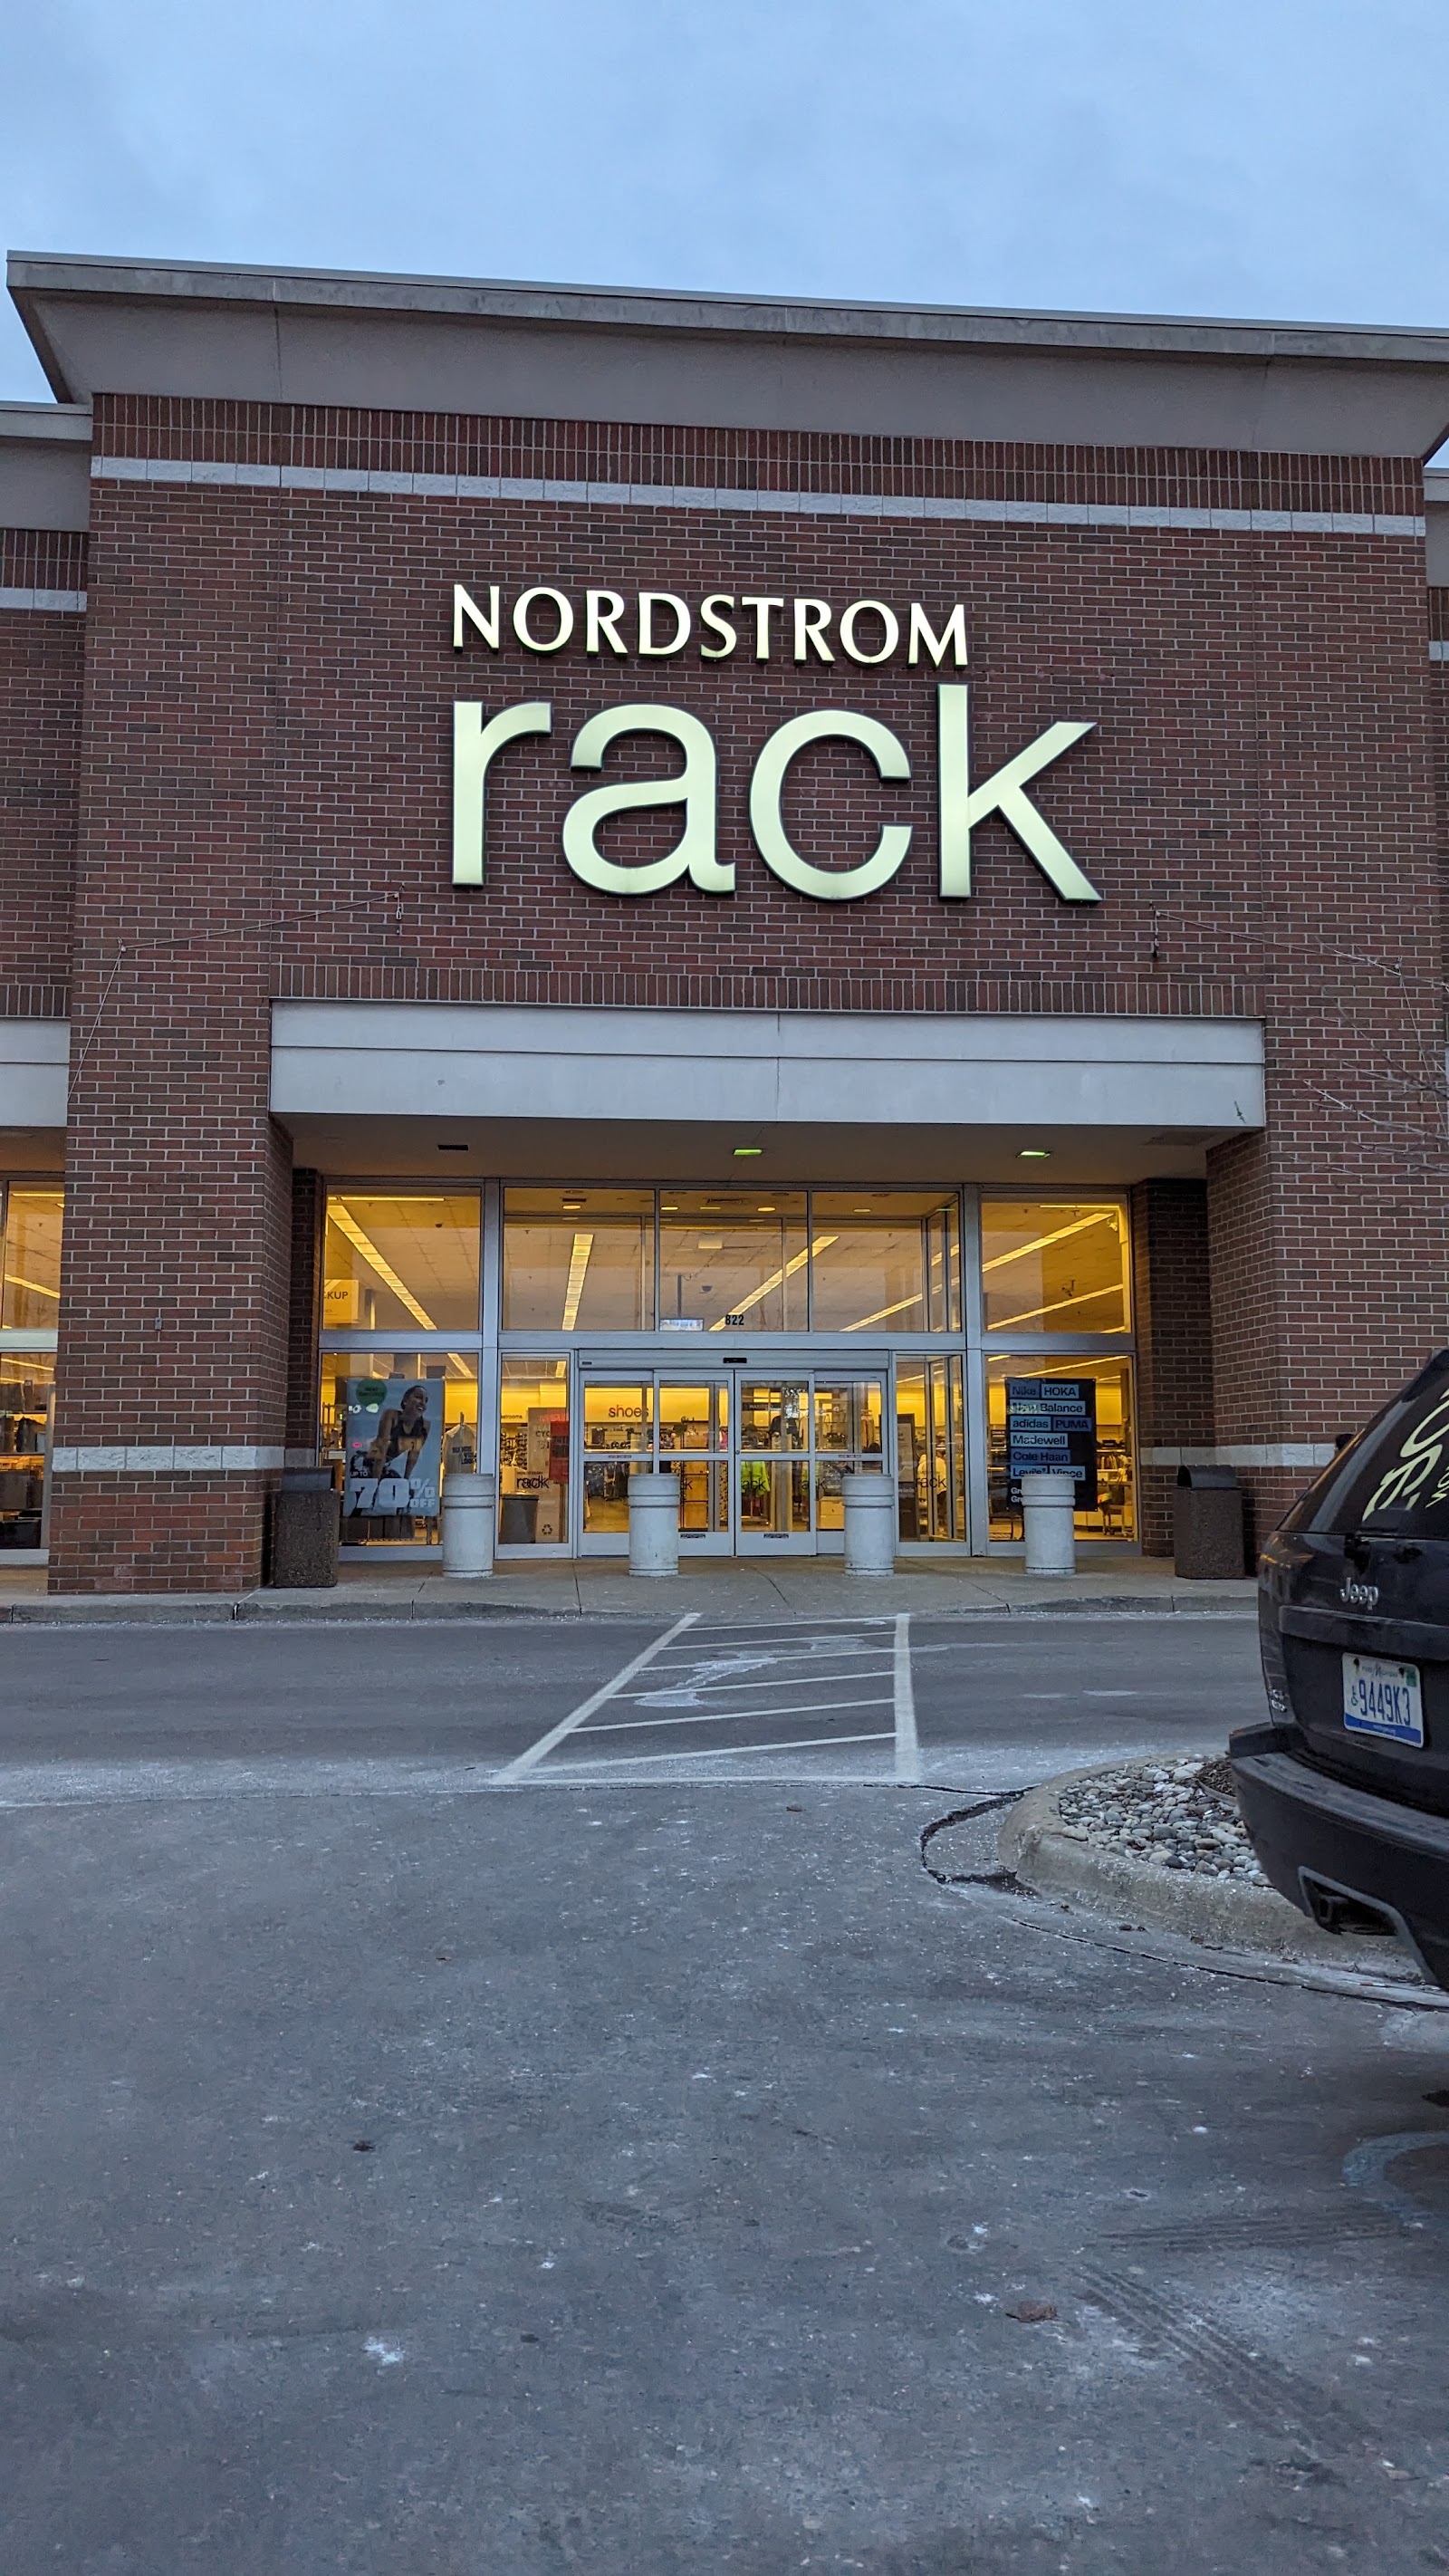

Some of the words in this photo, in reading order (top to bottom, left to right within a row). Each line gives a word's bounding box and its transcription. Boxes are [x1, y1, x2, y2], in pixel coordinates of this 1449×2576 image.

[453, 584, 968, 669] NORDSTROM
[452, 683, 1103, 903] rack
[724, 1314, 744, 1326] 822
[1012, 1386, 1037, 1396] Nike
[1043, 1387, 1077, 1396] HOKA
[1041, 1403, 1083, 1413] Balance
[1012, 1416, 1050, 1428] adidas
[1055, 1419, 1089, 1429] PUMA
[1012, 1435, 1066, 1445] Madewell
[1013, 1451, 1038, 1461] Cole
[1041, 1452, 1069, 1461] Haan
[409, 1499, 436, 1508] OFF
[1340, 1577, 1379, 1610] Jeep
[1358, 1679, 1411, 1725] 9449K3
